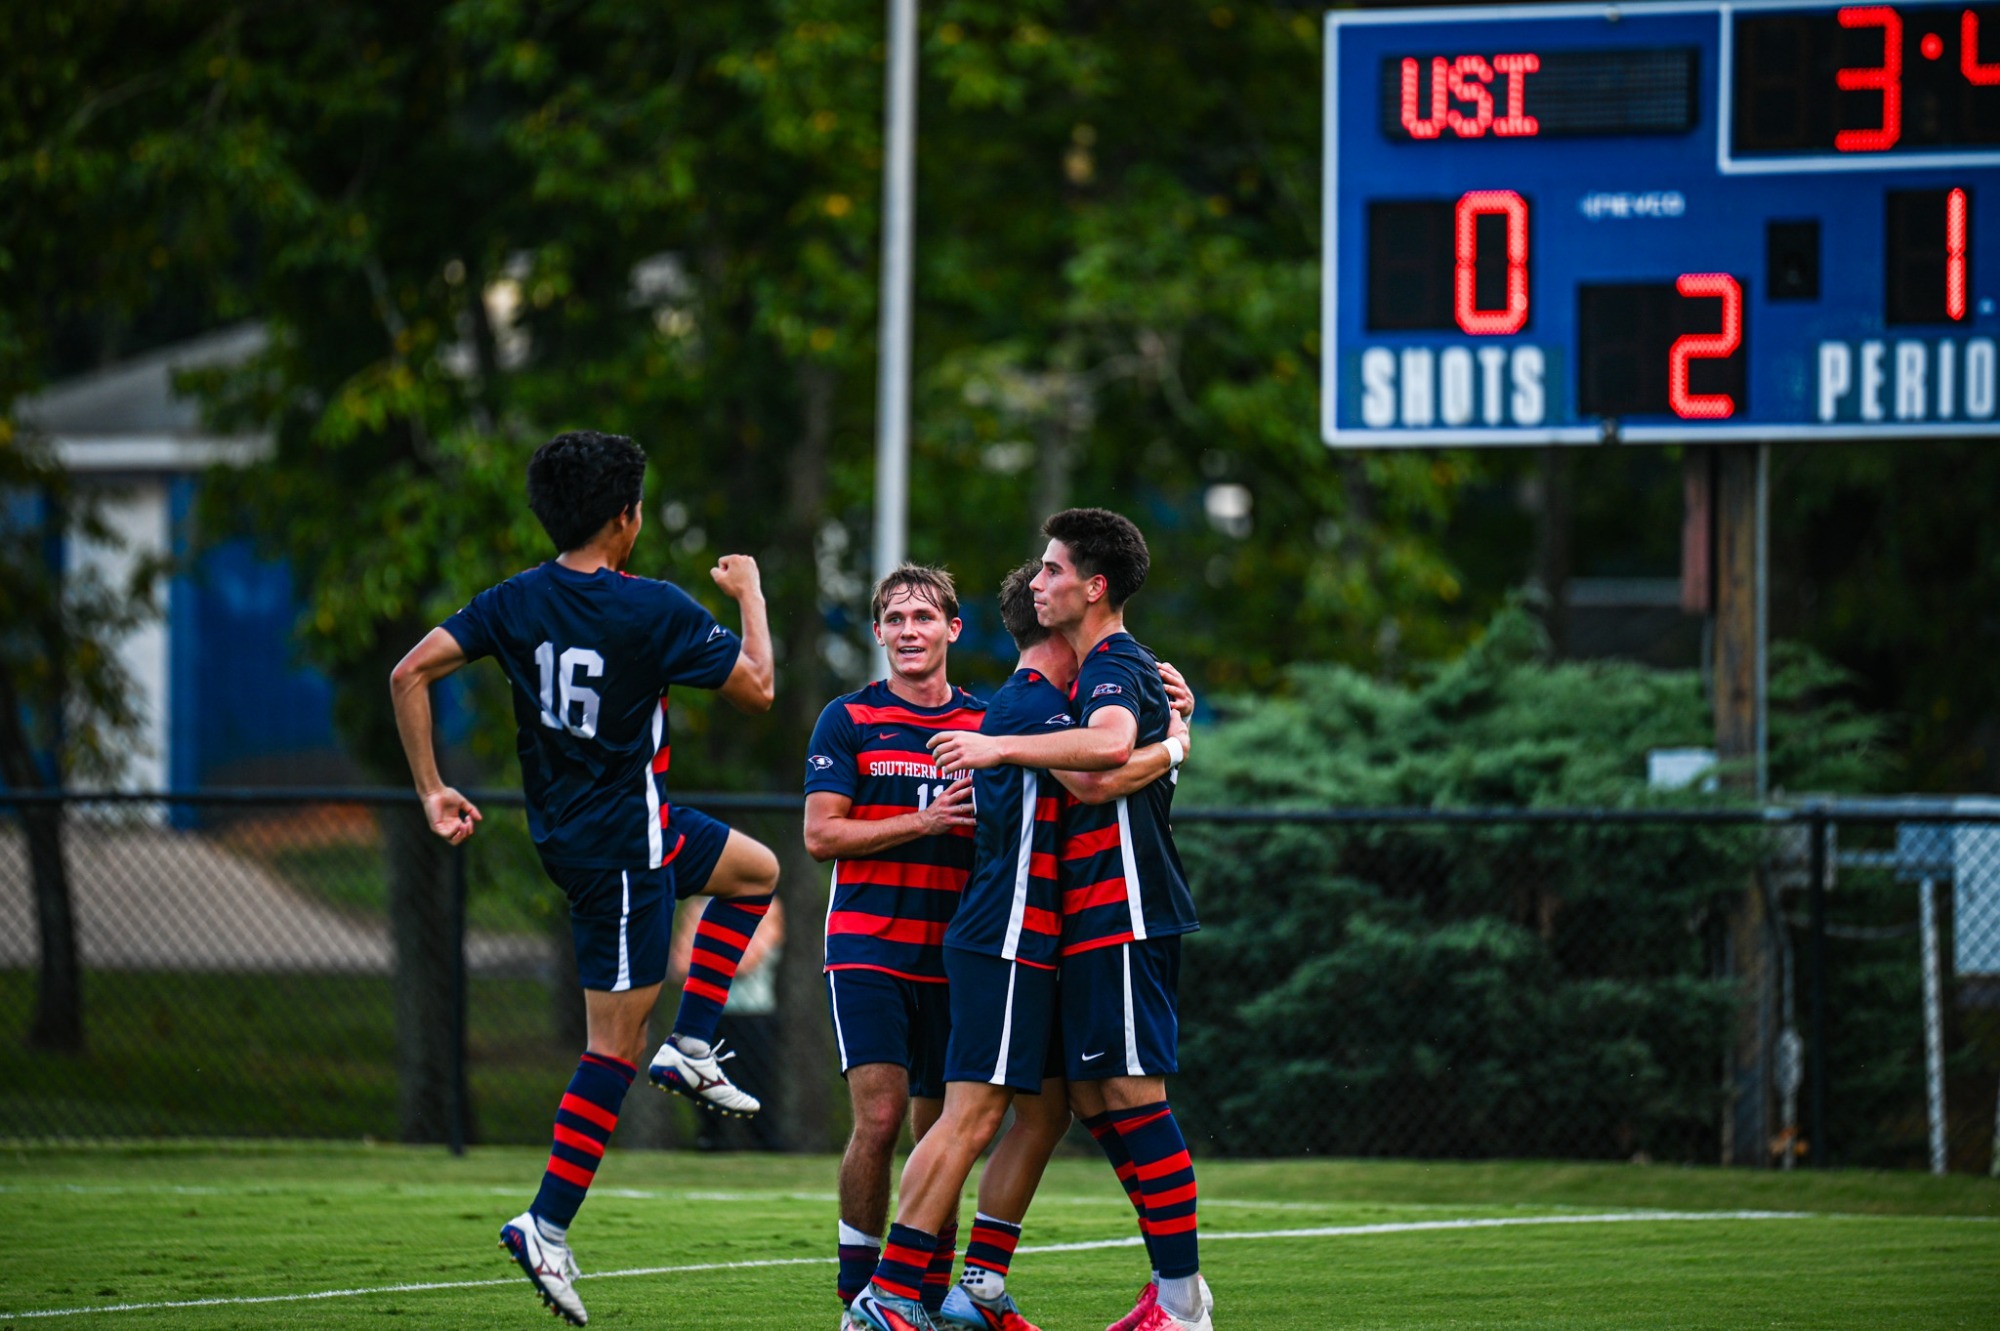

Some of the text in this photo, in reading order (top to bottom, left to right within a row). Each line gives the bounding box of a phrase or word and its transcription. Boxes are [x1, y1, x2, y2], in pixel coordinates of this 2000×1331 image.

[1401, 54, 1540, 139] USI
[1455, 190, 1528, 335] 0
[1946, 187, 1967, 321] 1
[1361, 346, 1546, 427] SHOTS
[1669, 273, 1742, 419] 2
[534, 641, 604, 739] 16
[869, 761, 937, 779] SOUTHERN
